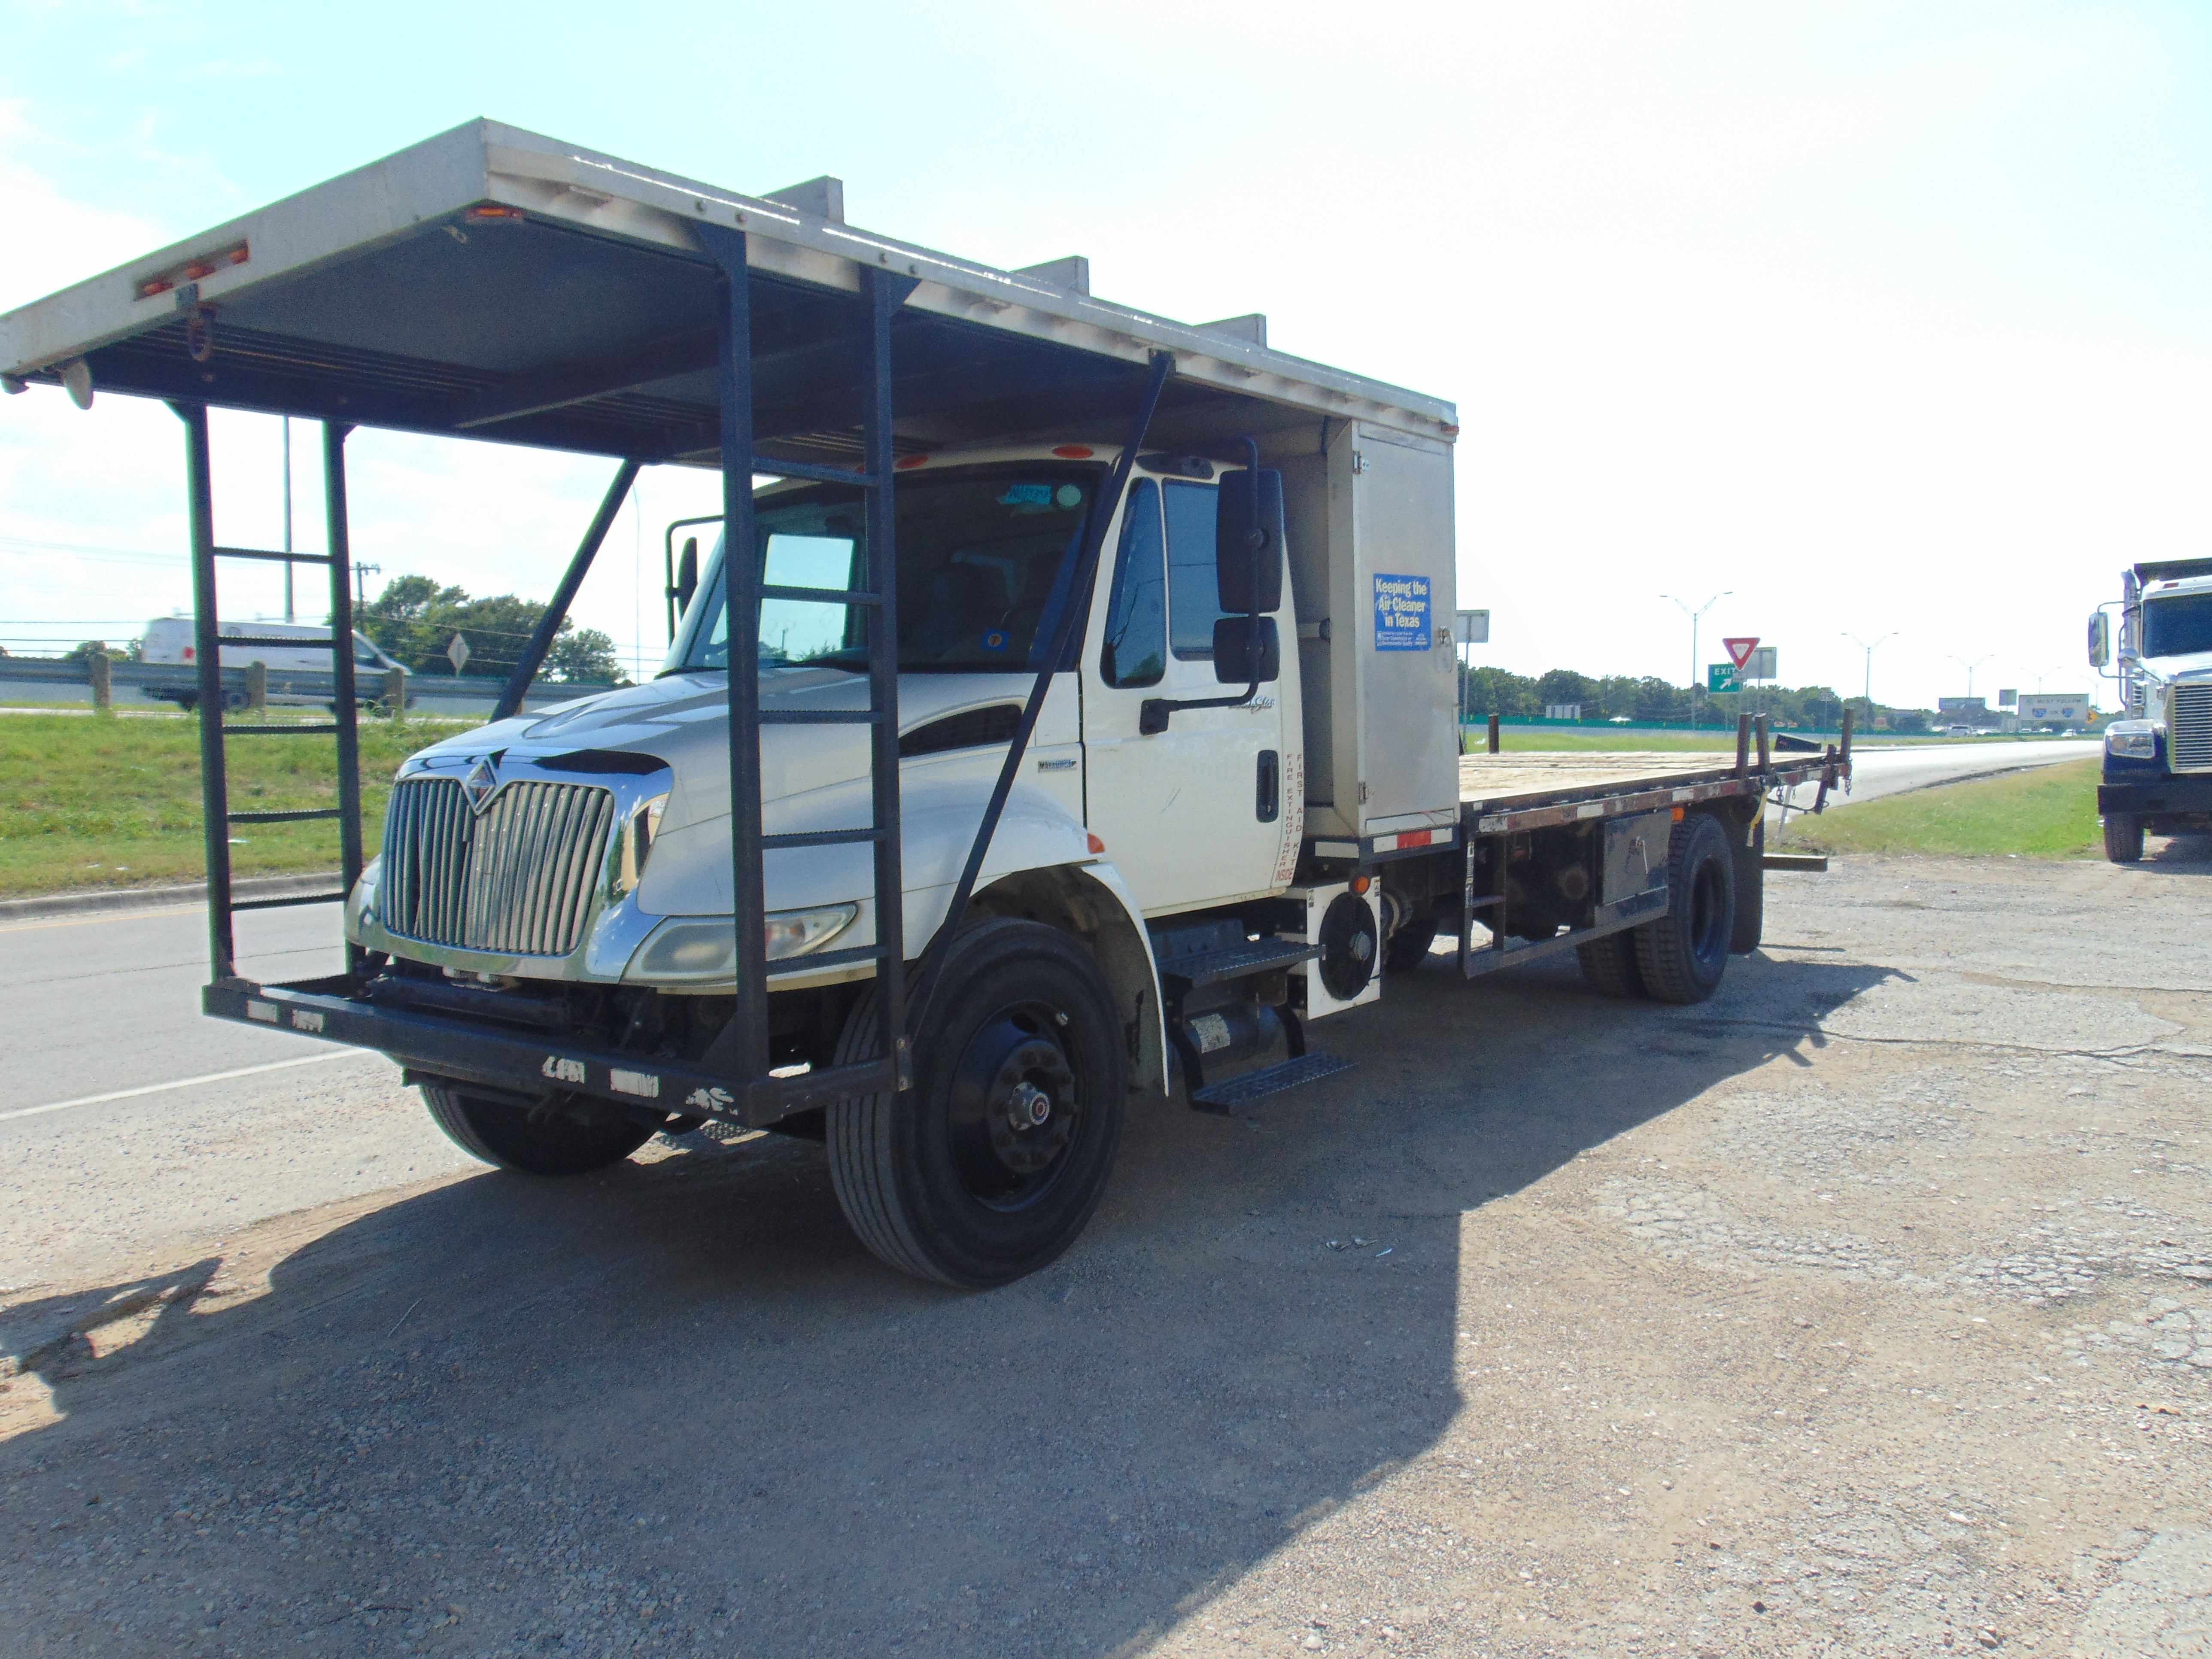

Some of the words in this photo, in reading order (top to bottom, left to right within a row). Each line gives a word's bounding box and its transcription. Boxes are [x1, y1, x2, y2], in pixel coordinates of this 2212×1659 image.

[1376, 578, 1411, 597] Keeping
[1413, 581, 1427, 595] the
[1378, 597, 1391, 611] Air
[1393, 597, 1425, 612] Cleaner
[1385, 613, 1393, 627] in
[1395, 613, 1420, 628] Texas
[1279, 788, 1293, 867] EXTINGUISHER
[1291, 842, 1300, 865] KIT
[1275, 868, 1294, 882] INSIDE
